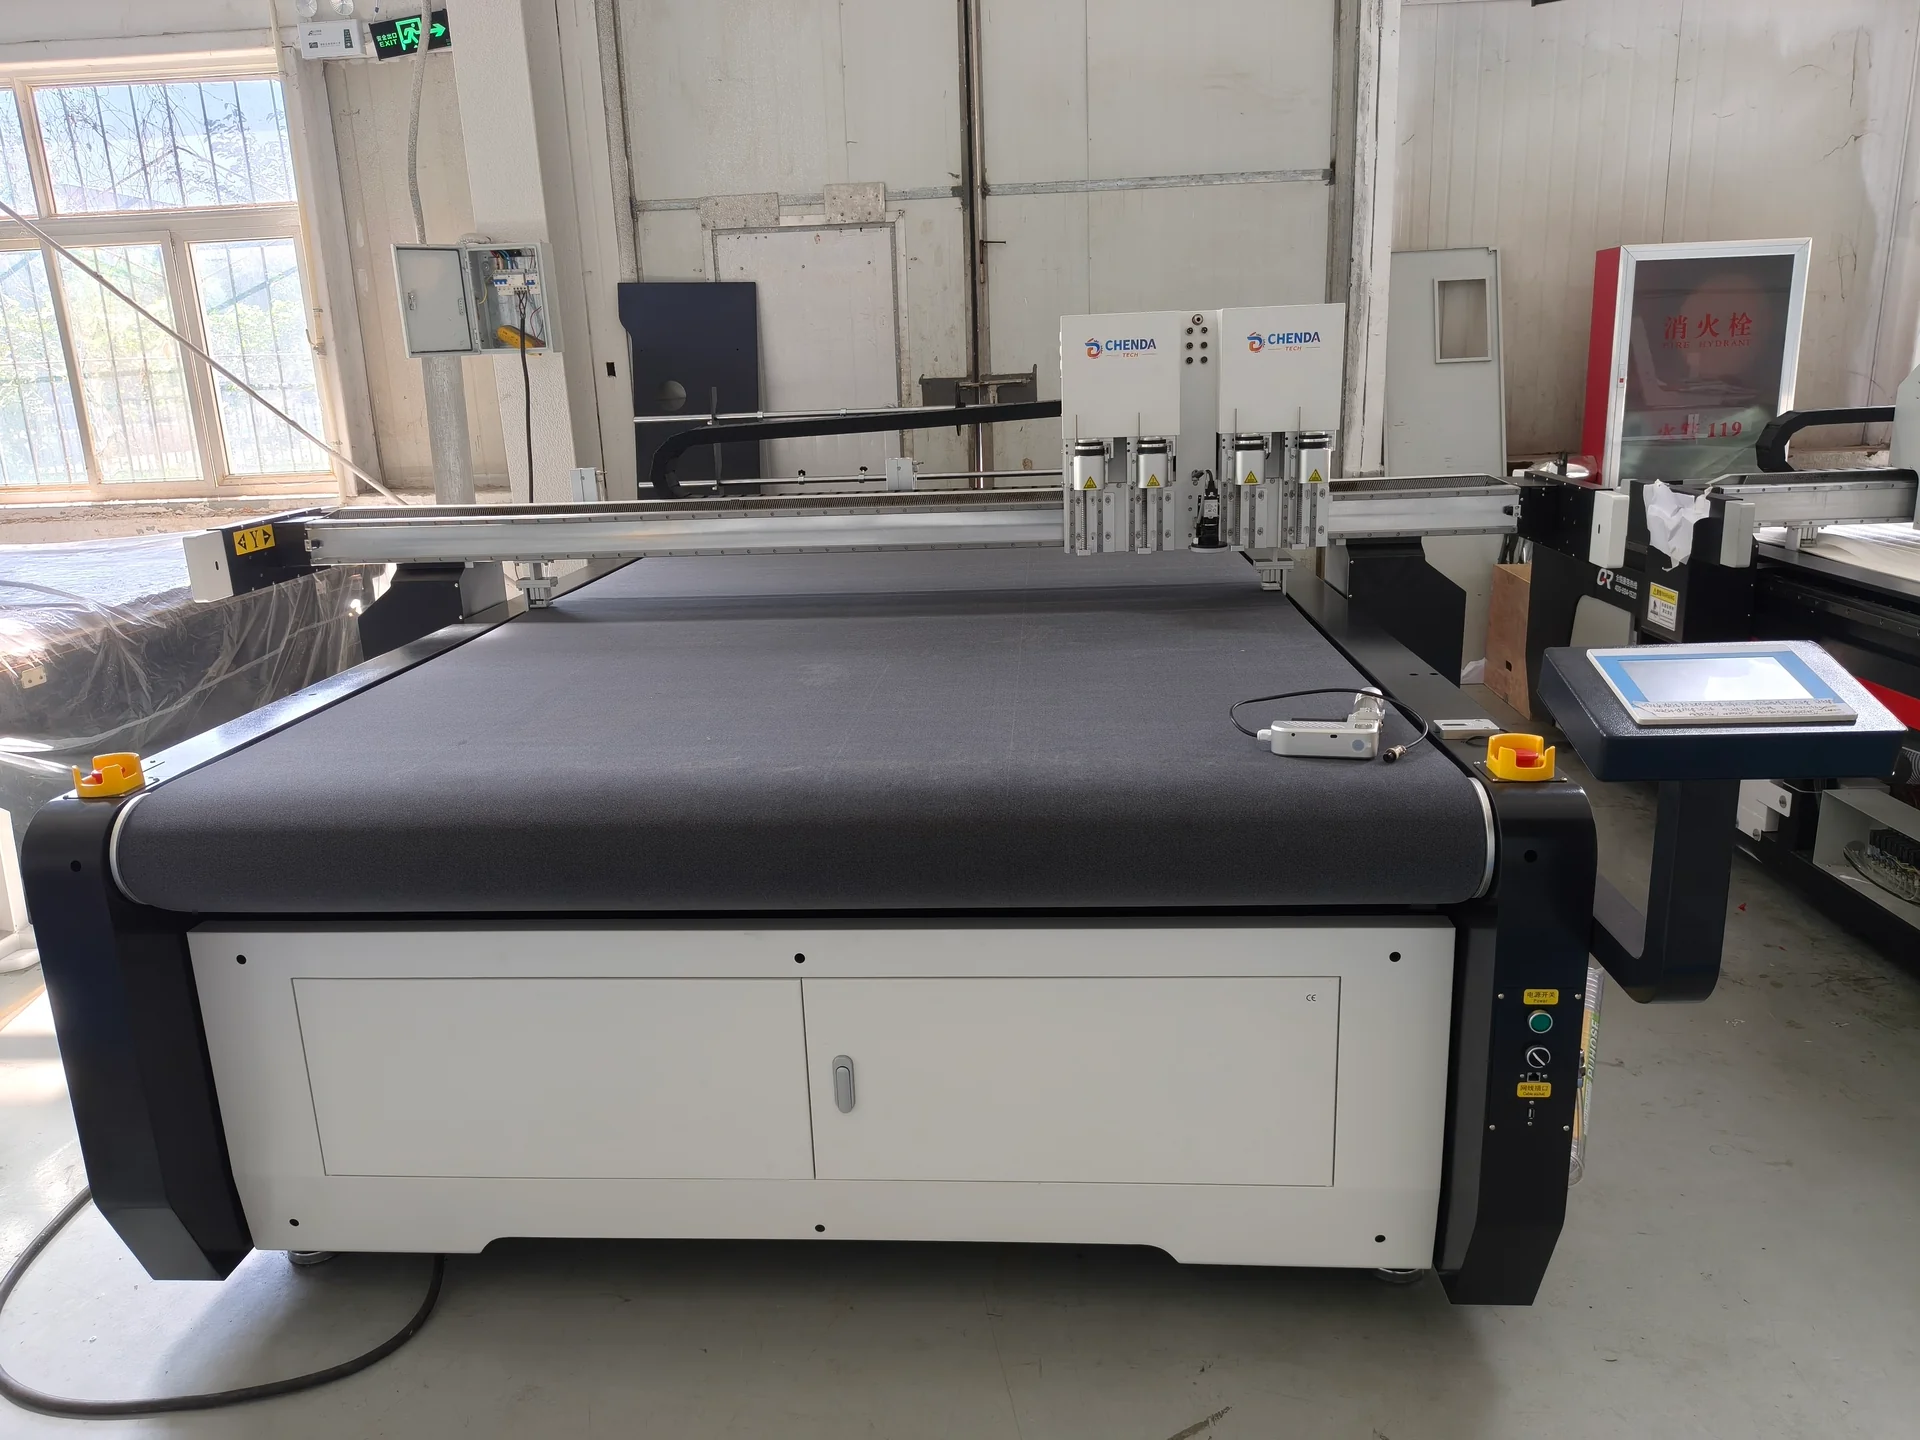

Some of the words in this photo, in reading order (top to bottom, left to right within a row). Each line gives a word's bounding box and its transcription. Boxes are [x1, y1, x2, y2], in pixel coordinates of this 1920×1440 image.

[376, 32, 398, 41] 安全出口
[379, 39, 398, 48] EXIT
[1663, 312, 1752, 340] 消火栓
[1267, 331, 1321, 345] CHENDA
[1699, 339, 1750, 348] HYDRANT
[1105, 338, 1157, 351] CHENDA
[1707, 421, 1742, 438] 119
[1526, 991, 1556, 999] 电源开关
